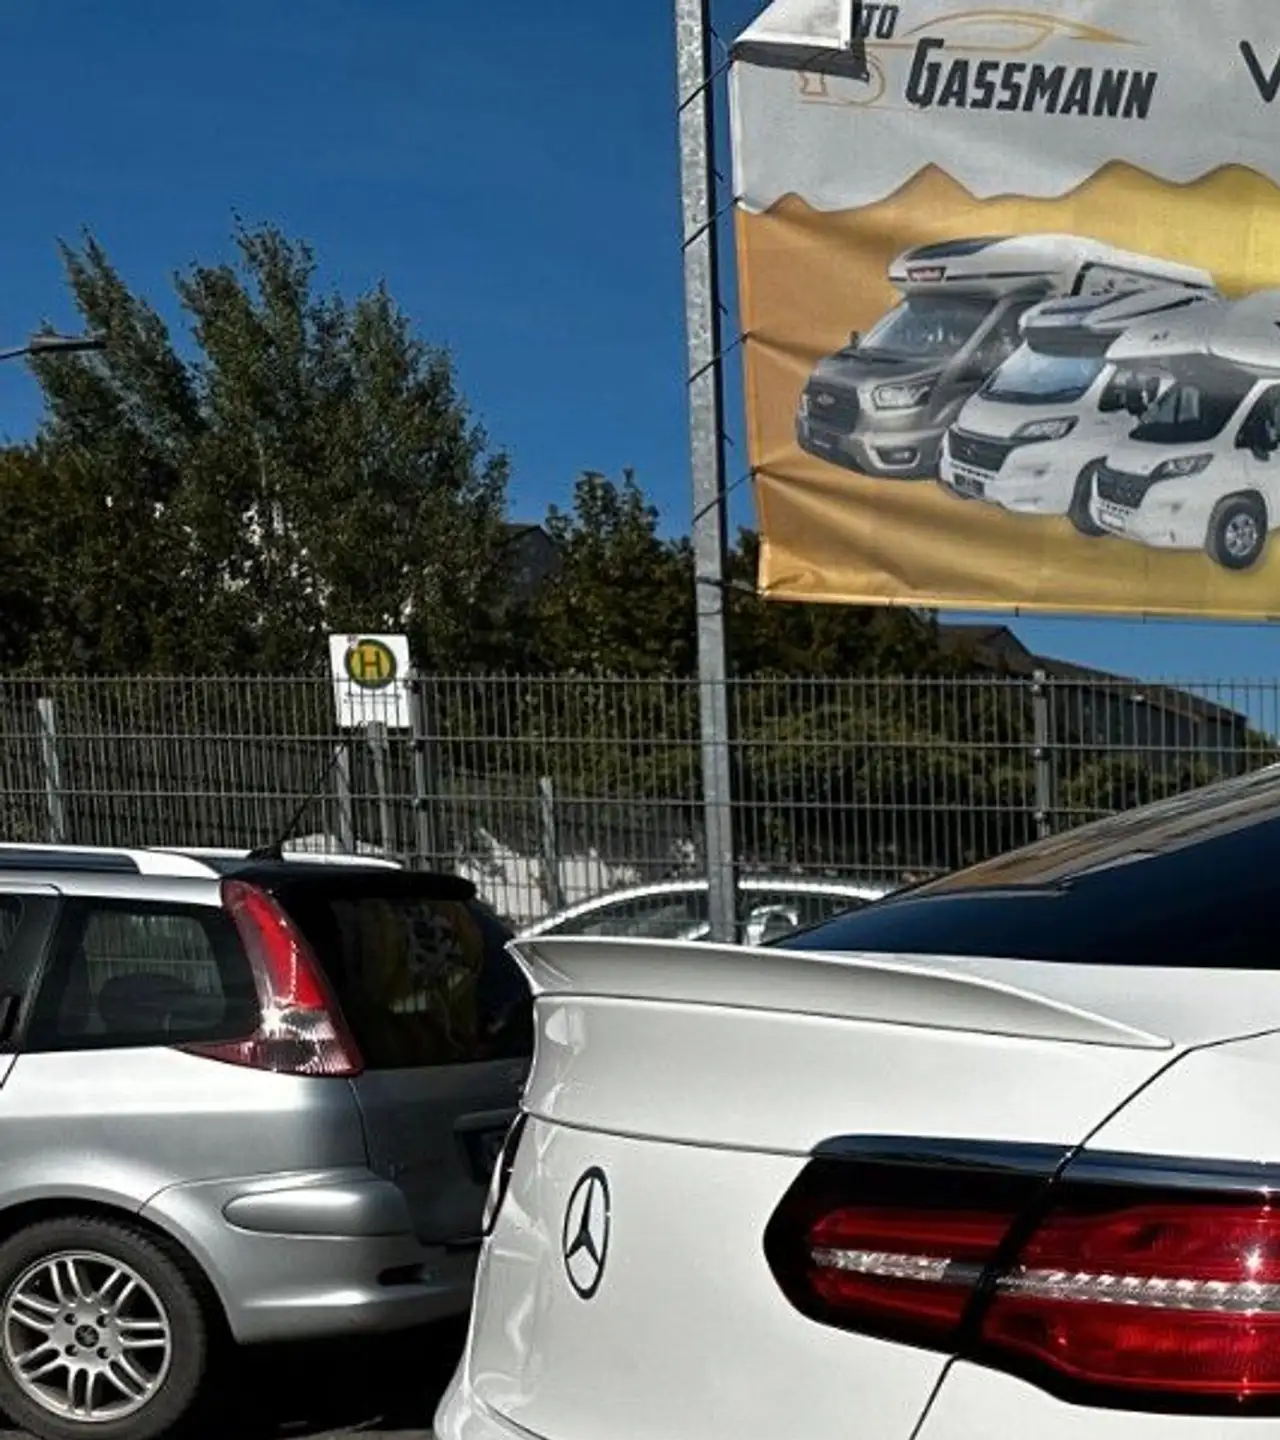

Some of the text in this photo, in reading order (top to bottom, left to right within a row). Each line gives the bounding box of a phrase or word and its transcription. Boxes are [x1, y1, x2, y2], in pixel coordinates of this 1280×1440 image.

[862, 4, 899, 39] TO
[905, 37, 1158, 120] GASSMANN
[360, 649, 383, 678] H
